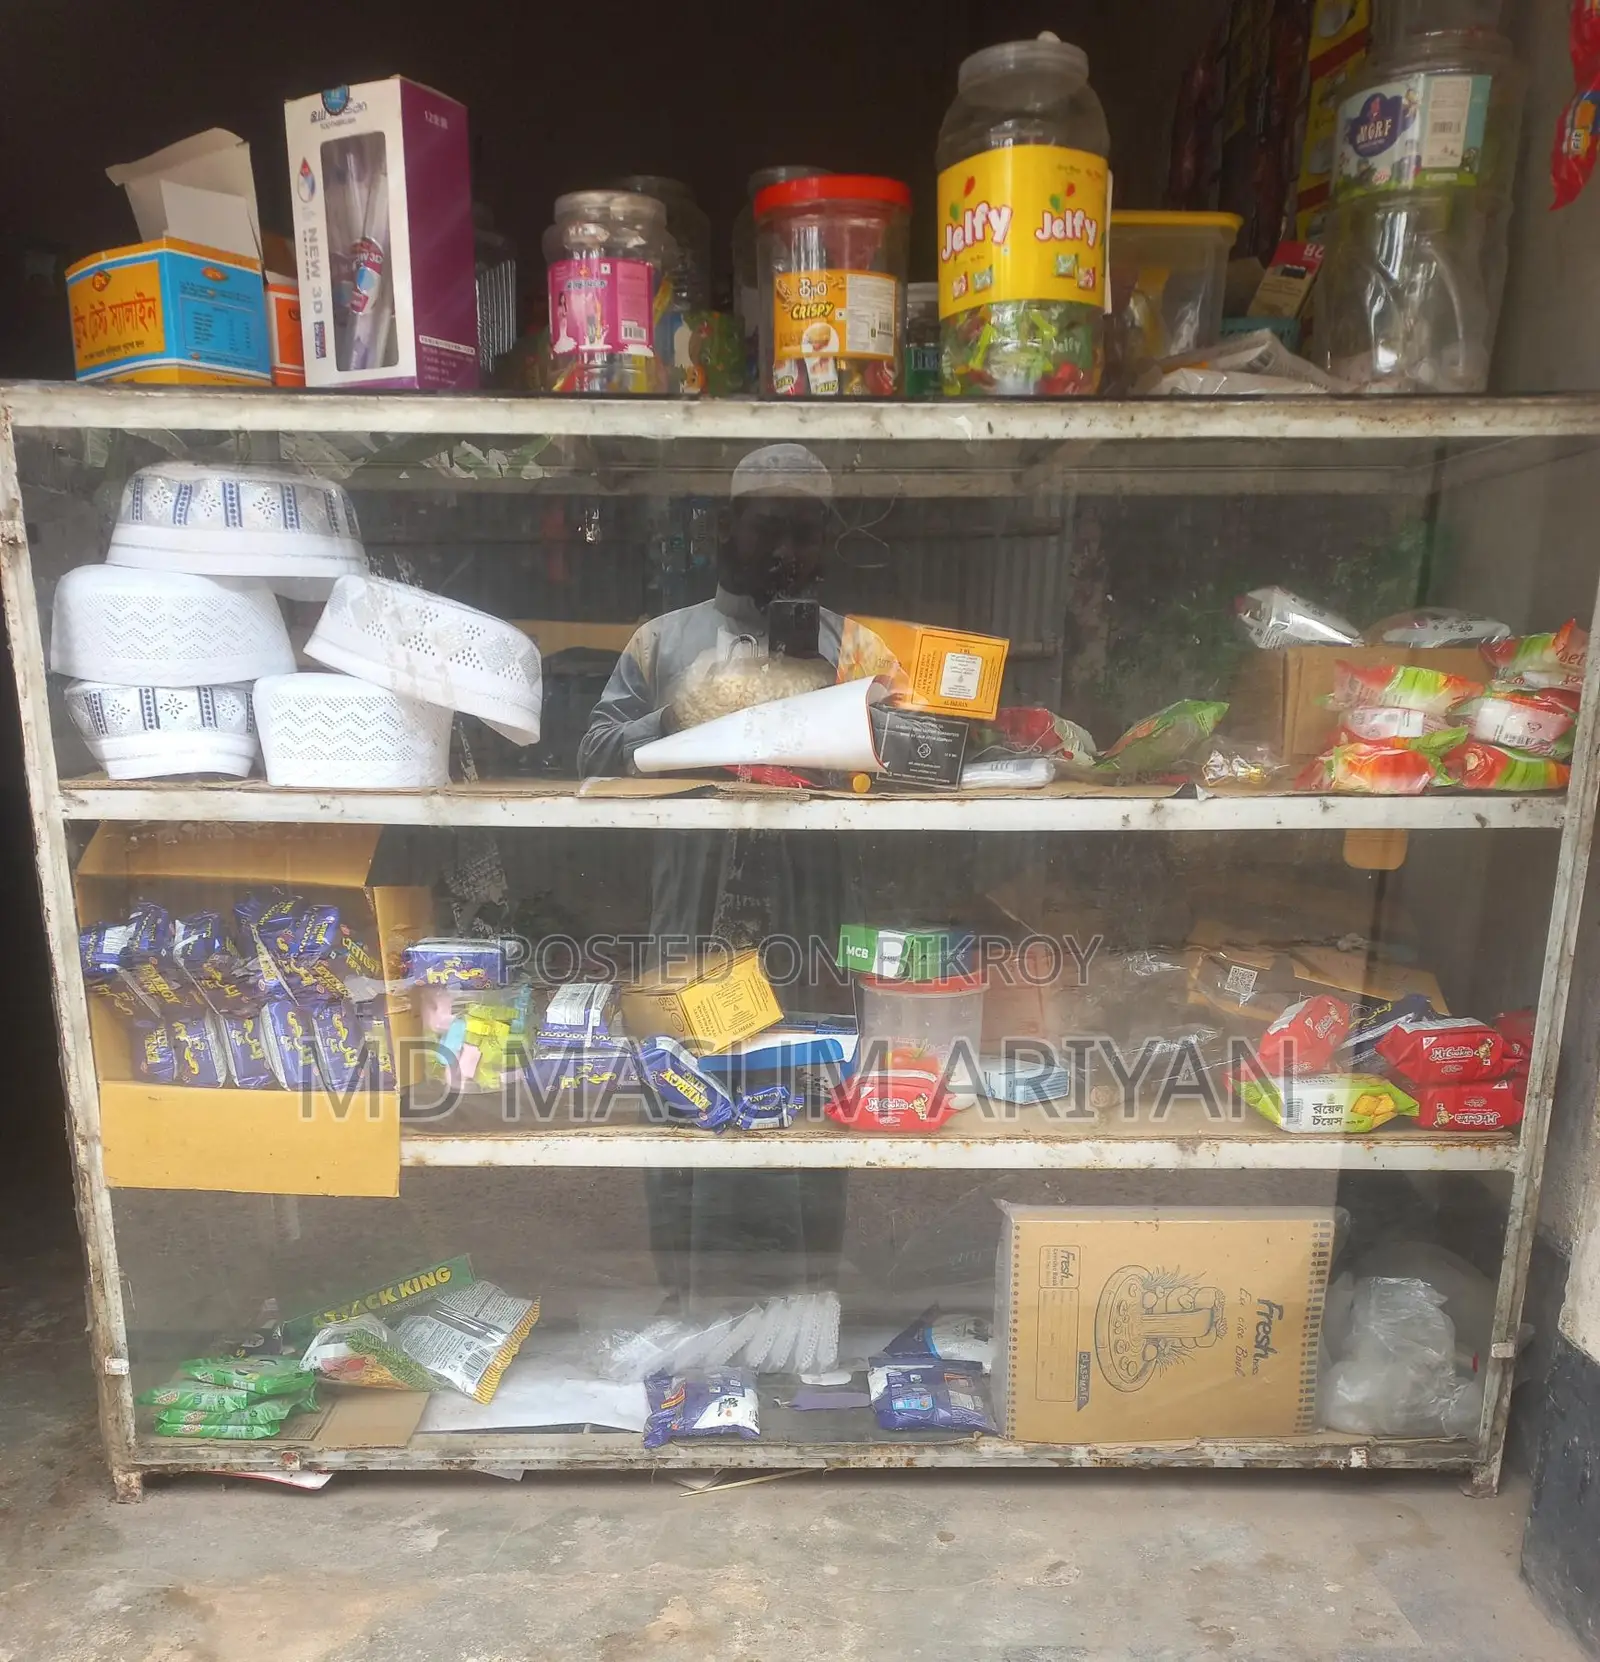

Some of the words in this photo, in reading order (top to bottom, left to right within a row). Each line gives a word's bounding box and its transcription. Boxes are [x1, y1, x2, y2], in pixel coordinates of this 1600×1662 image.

[941, 201, 1013, 262] Jelfy
[1034, 208, 1097, 248] Jelfy
[309, 228, 320, 279] NEW
[311, 286, 323, 314] 3D
[791, 301, 834, 320] CRISPY
[846, 945, 869, 959] MCB
[660, 1068, 712, 1112] ENERGY
[1060, 1250, 1076, 1279] Fresh
[397, 1266, 452, 1298] KING
[1079, 1352, 1090, 1402] CLASSMATE
[1233, 1346, 1249, 1377] Book
